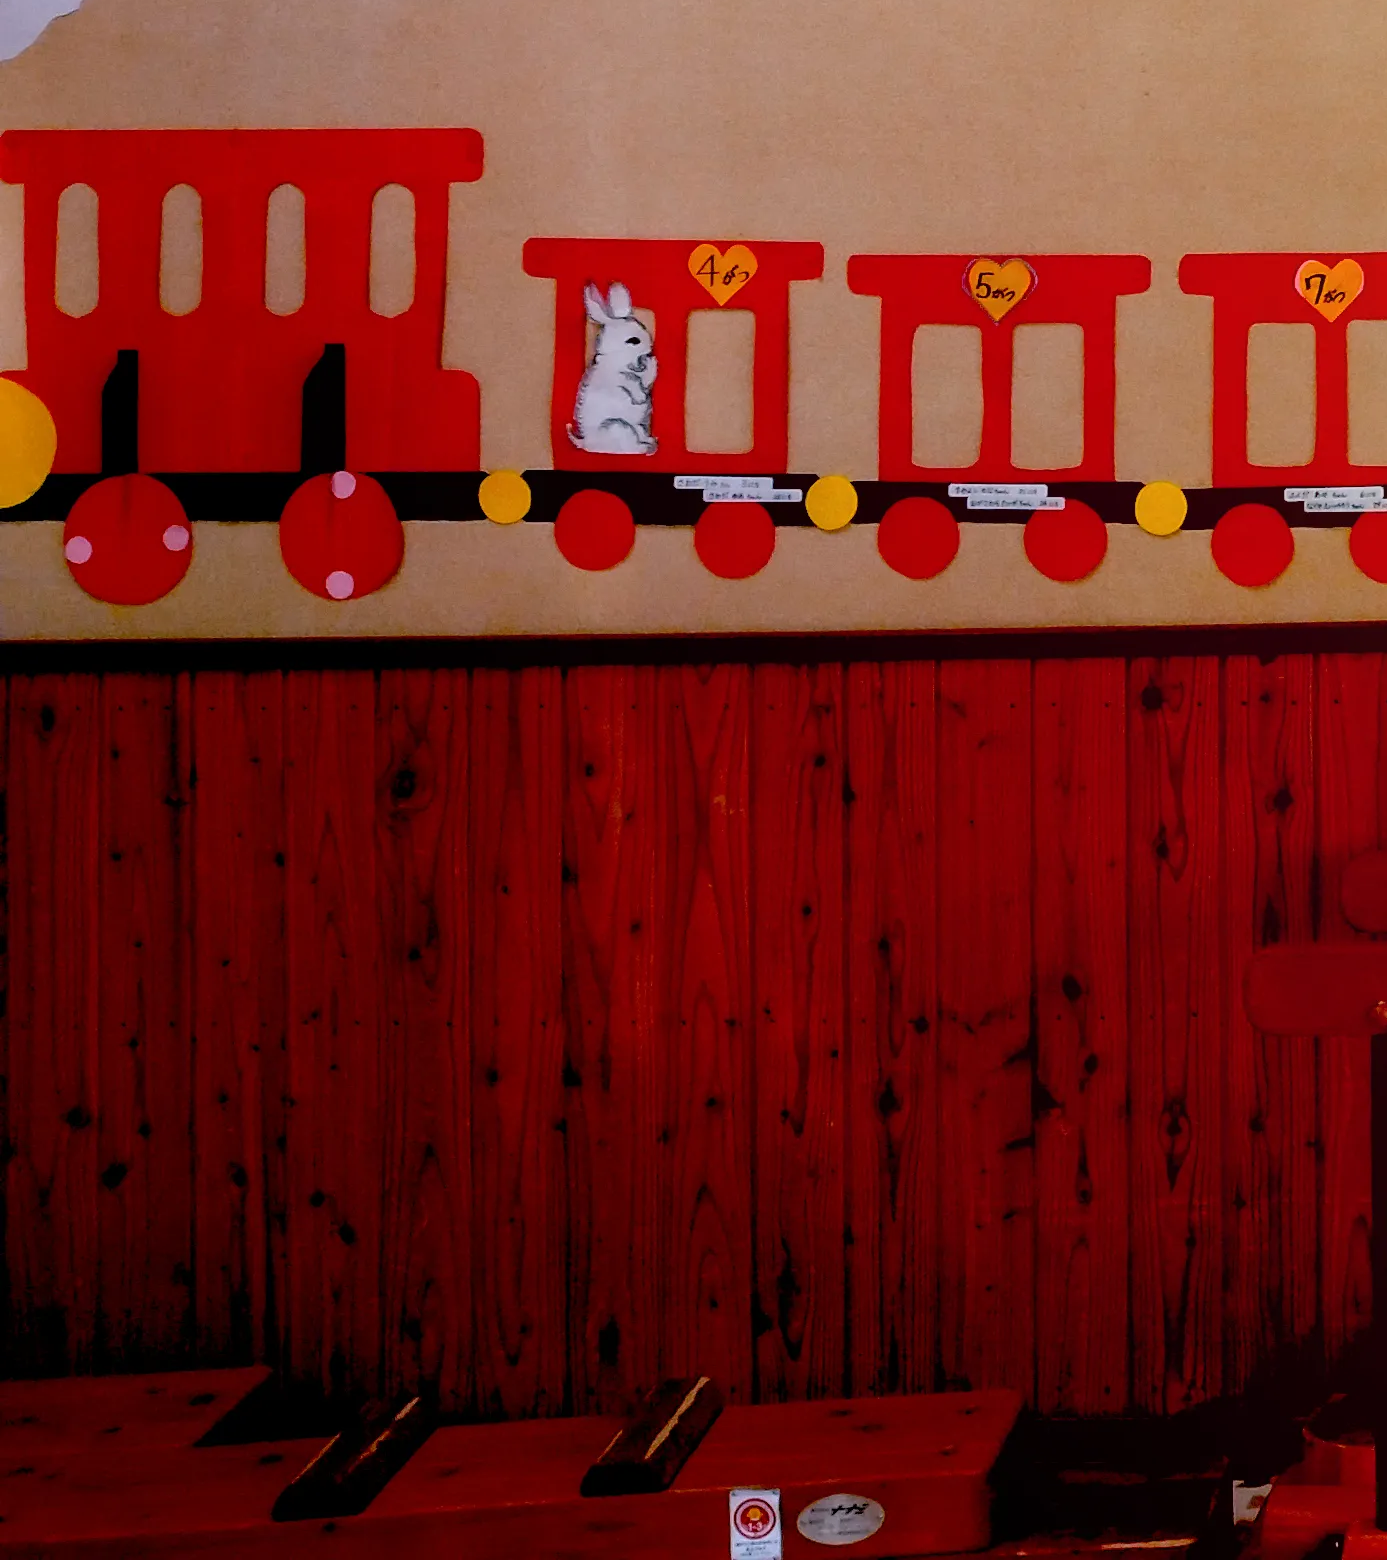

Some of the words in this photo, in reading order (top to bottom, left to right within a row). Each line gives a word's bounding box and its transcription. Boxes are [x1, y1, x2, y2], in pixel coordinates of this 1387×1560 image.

[695, 254, 750, 288] 4がつ
[974, 271, 1016, 302] 5がつ
[1303, 272, 1347, 305] 7がつ
